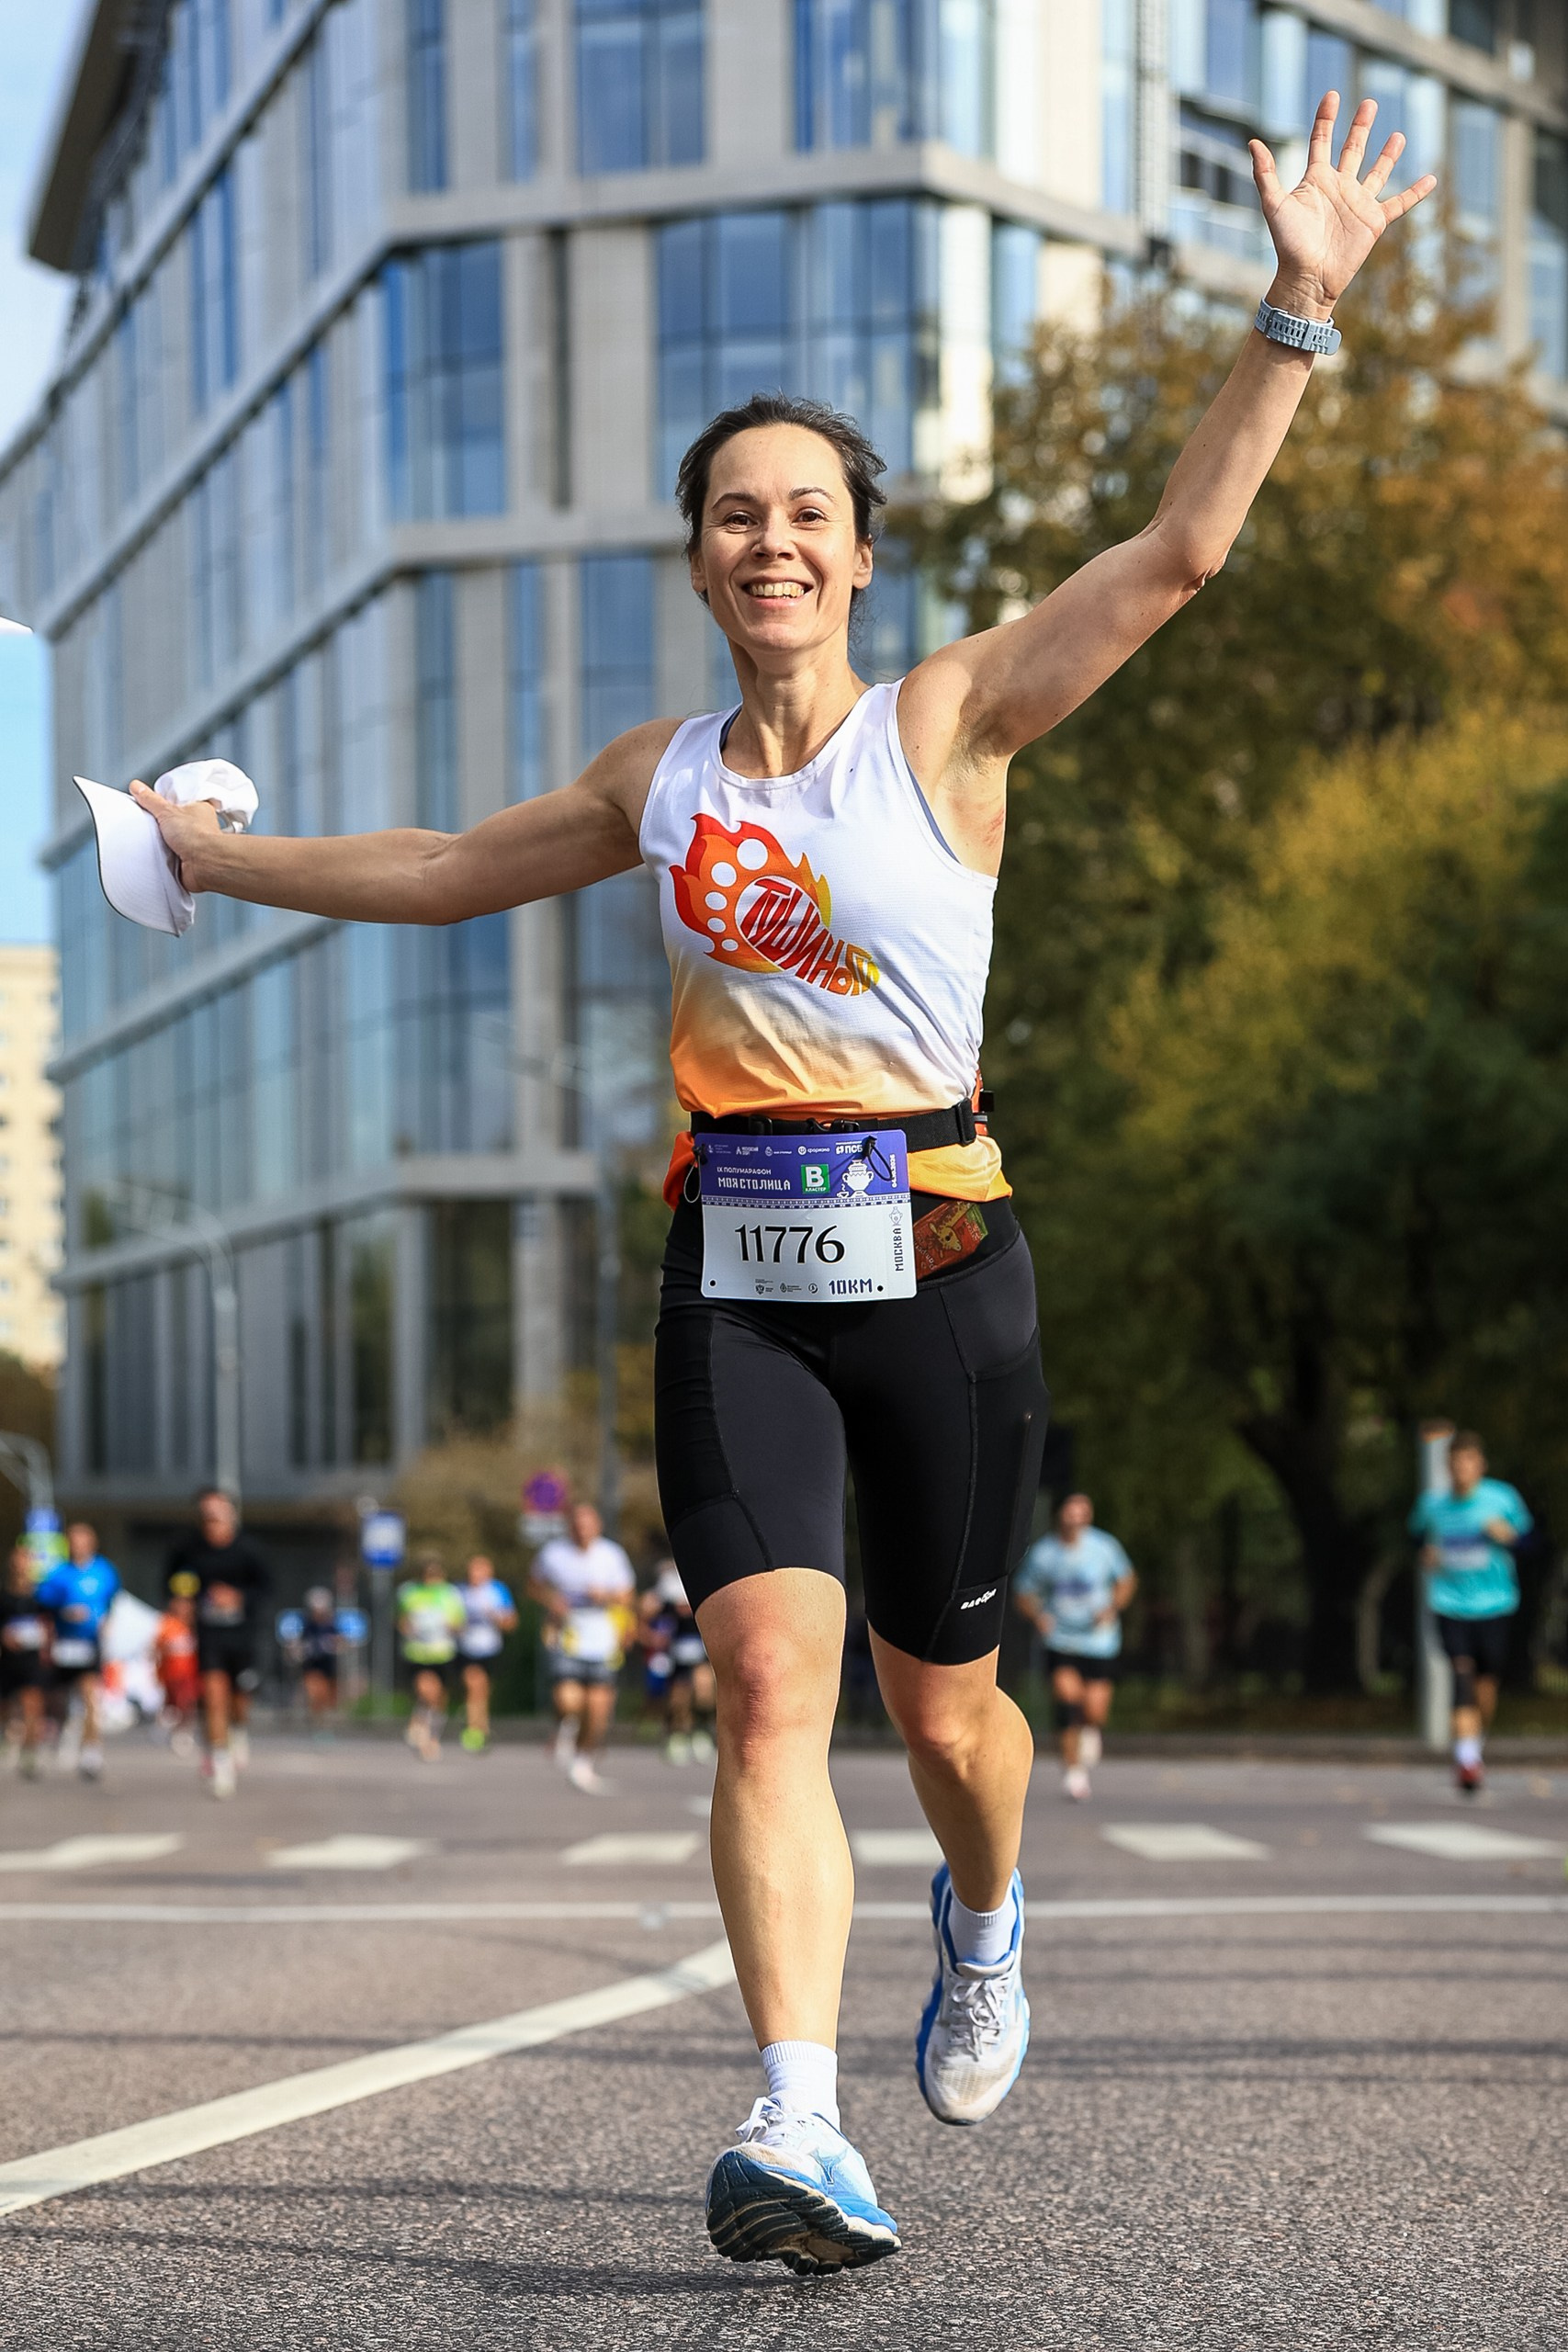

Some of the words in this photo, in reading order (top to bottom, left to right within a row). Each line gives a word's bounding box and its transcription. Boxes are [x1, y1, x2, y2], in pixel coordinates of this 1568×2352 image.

[844, 1144, 863, 1154] ПСБ
[723, 1167, 772, 1175] ПОЛУМАРАФОН
[717, 1177, 739, 1189] МОЯ
[739, 1178, 791, 1192] СТОЛИЦА
[734, 1223, 846, 1264] 11776
[893, 1227, 904, 1272] МОСКВА
